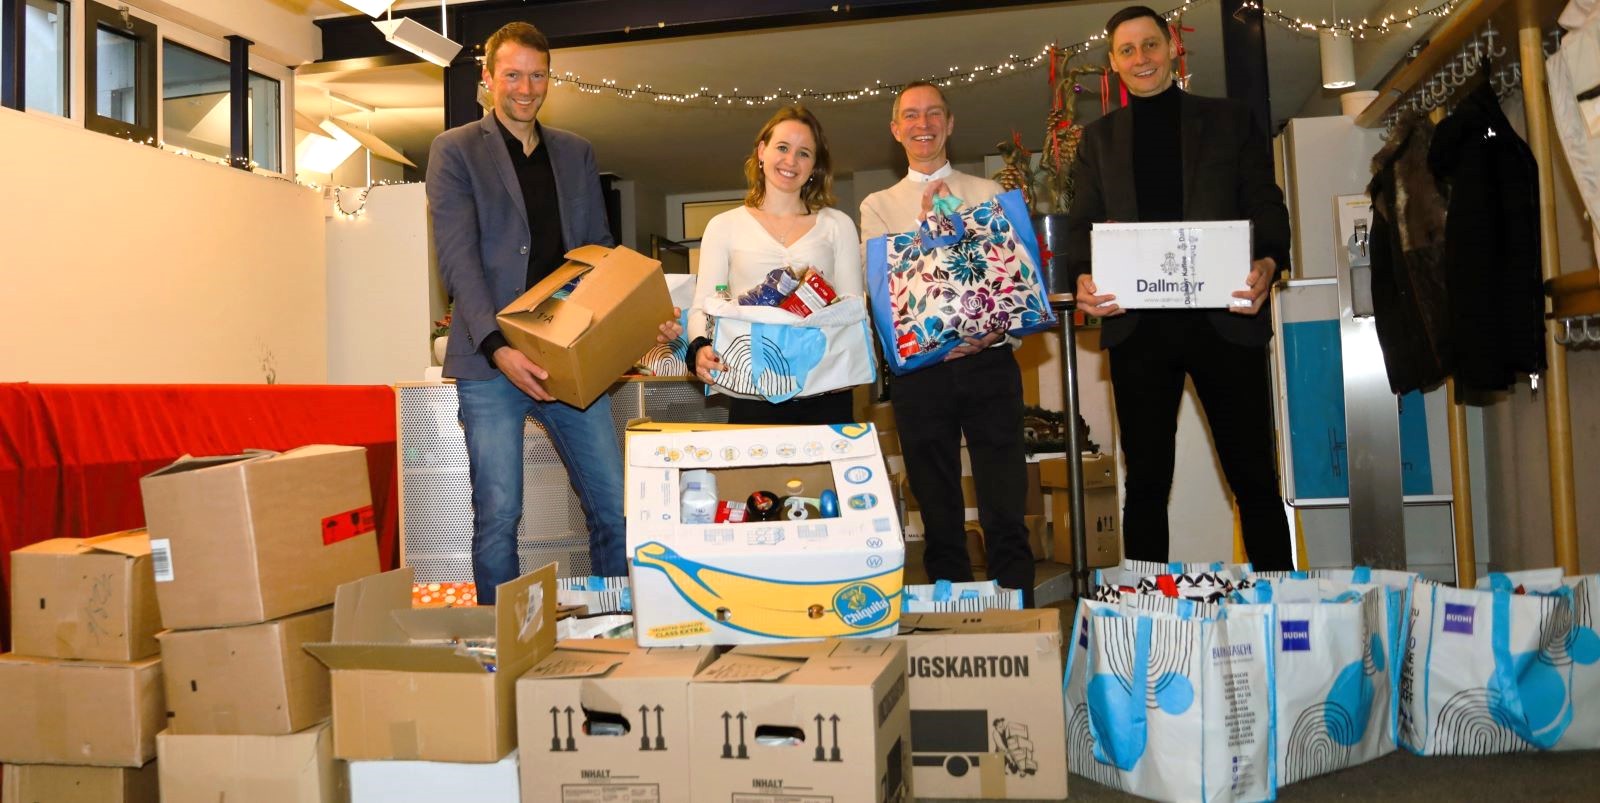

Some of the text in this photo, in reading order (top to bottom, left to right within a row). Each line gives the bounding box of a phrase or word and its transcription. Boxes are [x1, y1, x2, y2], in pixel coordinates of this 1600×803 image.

[1136, 279, 1205, 295] Dallmayr
[842, 599, 890, 625] Chiquita
[1283, 631, 1308, 640] BUDNI
[580, 769, 611, 779] INHALT
[751, 778, 784, 789] INHALT
